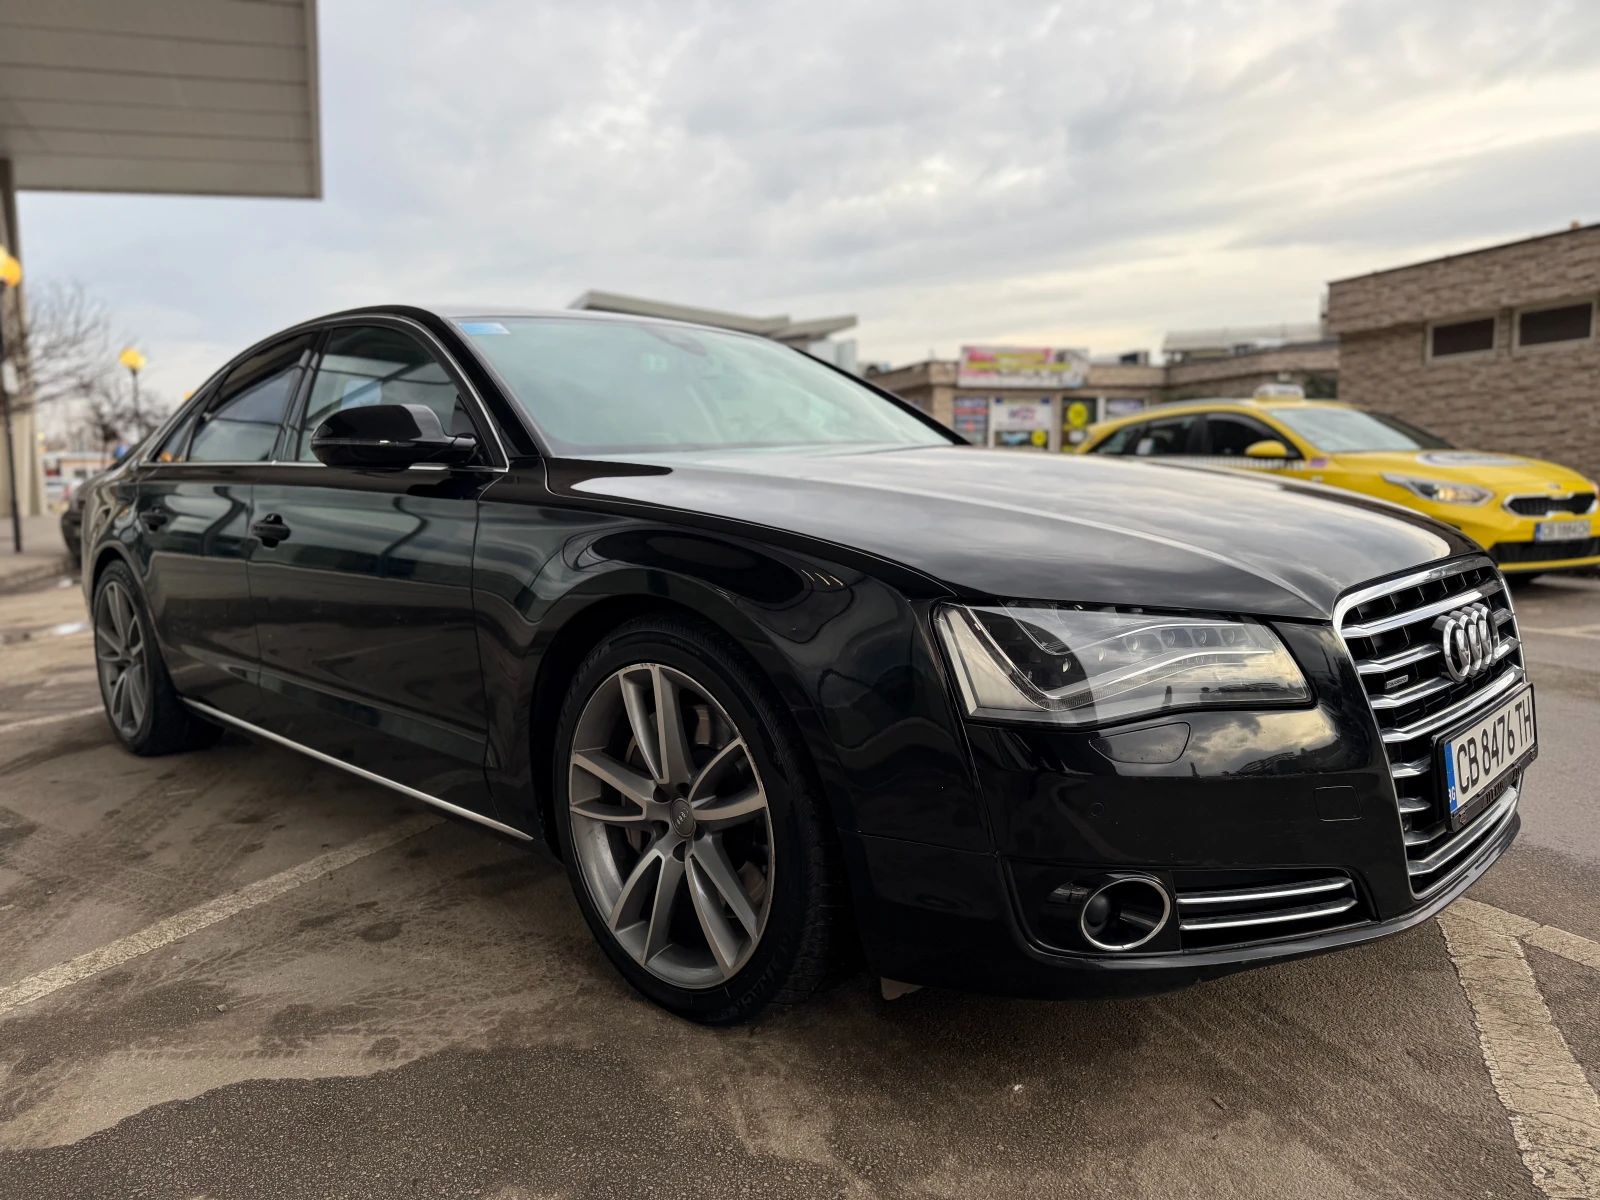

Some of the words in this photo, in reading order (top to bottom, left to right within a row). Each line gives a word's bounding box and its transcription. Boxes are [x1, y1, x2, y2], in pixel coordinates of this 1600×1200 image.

[1457, 737, 1479, 795] CB
[1481, 710, 1515, 776] 8476
[1515, 695, 1532, 747] TH
